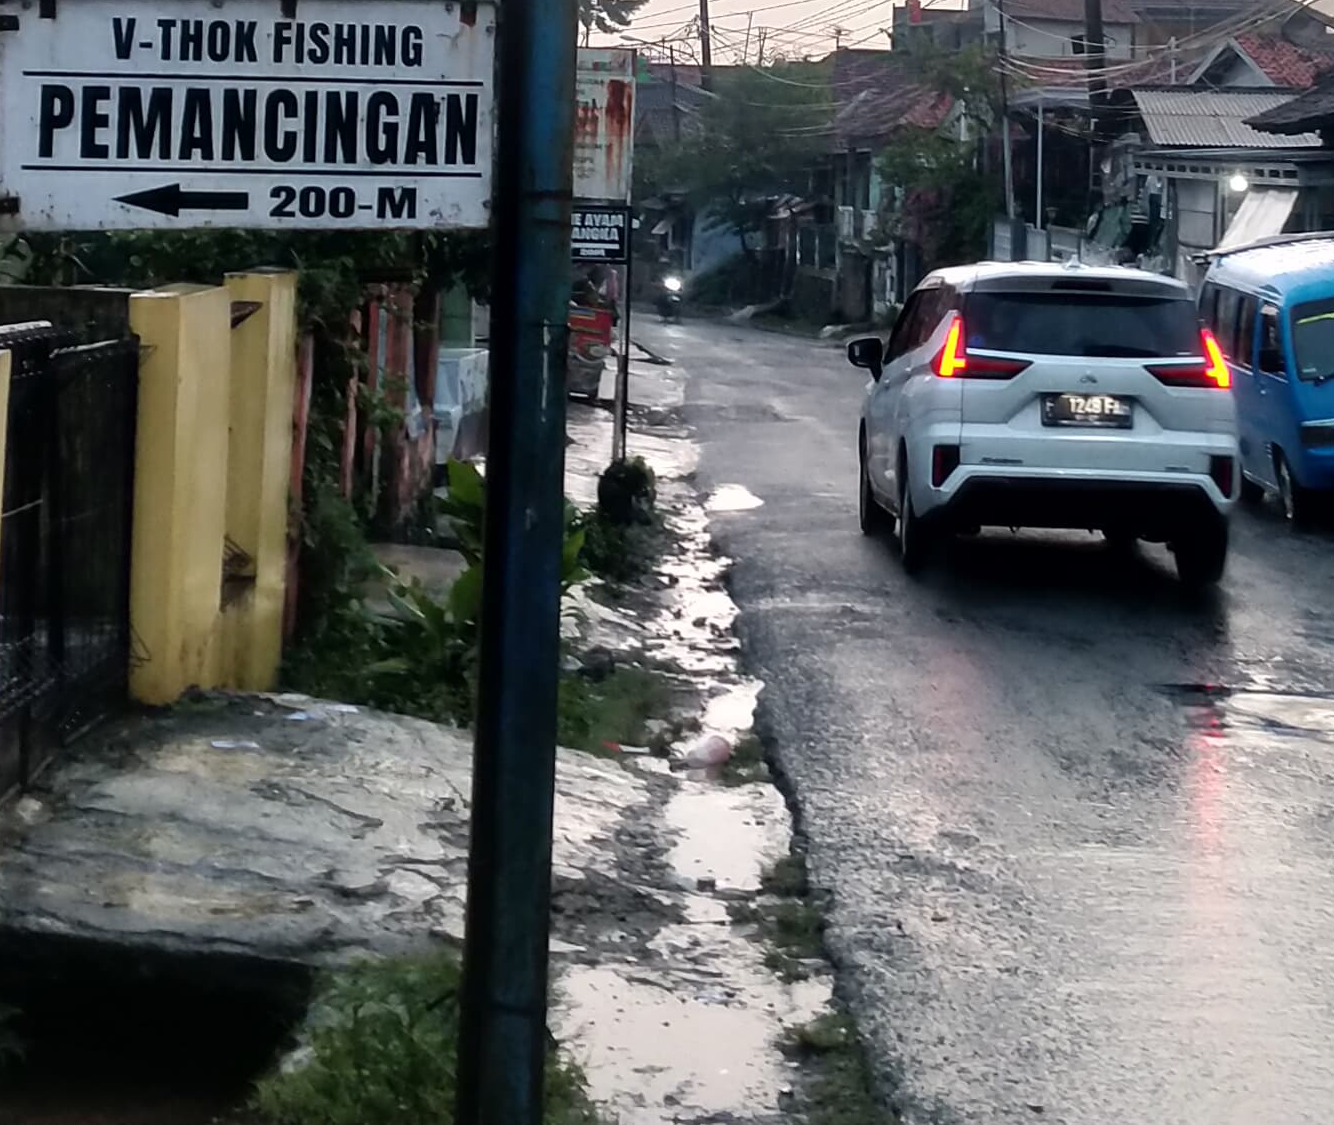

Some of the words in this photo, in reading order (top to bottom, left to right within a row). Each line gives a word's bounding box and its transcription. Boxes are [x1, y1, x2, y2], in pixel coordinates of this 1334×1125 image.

[112, 17, 258, 63] V-THOK
[272, 21, 424, 68] FISHING
[38, 83, 479, 166] PEMANCINGAN
[269, 185, 417, 220] 200-M
[571, 226, 620, 241] ANGKA
